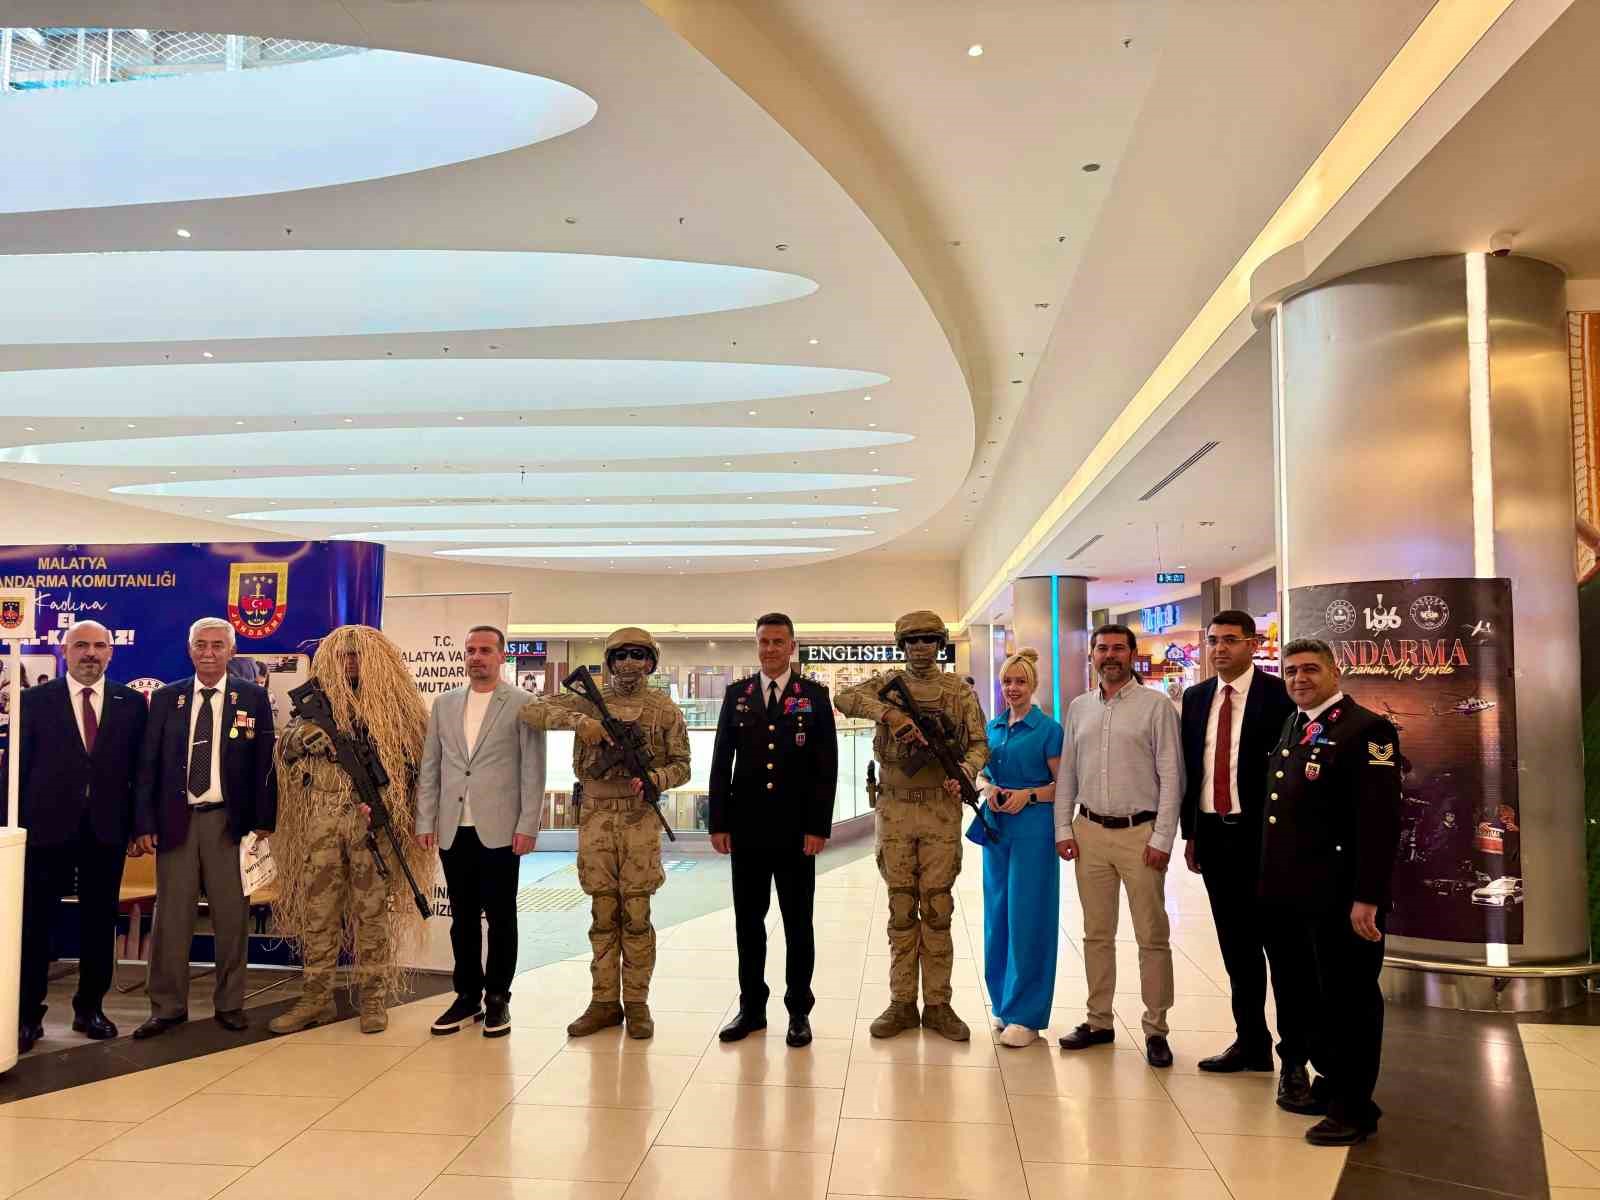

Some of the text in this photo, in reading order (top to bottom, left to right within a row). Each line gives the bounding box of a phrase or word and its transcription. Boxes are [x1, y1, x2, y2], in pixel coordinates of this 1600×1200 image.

[38, 557, 107, 570] MALATYA
[72, 571, 176, 588] KOMUTANLIĞI
[433, 635, 454, 647] T.C.
[400, 651, 446, 662] ALATYA
[808, 645, 948, 661] ENGLISH HE
[1328, 638, 1469, 667] ANDARMA
[416, 666, 469, 678] JANDAR
